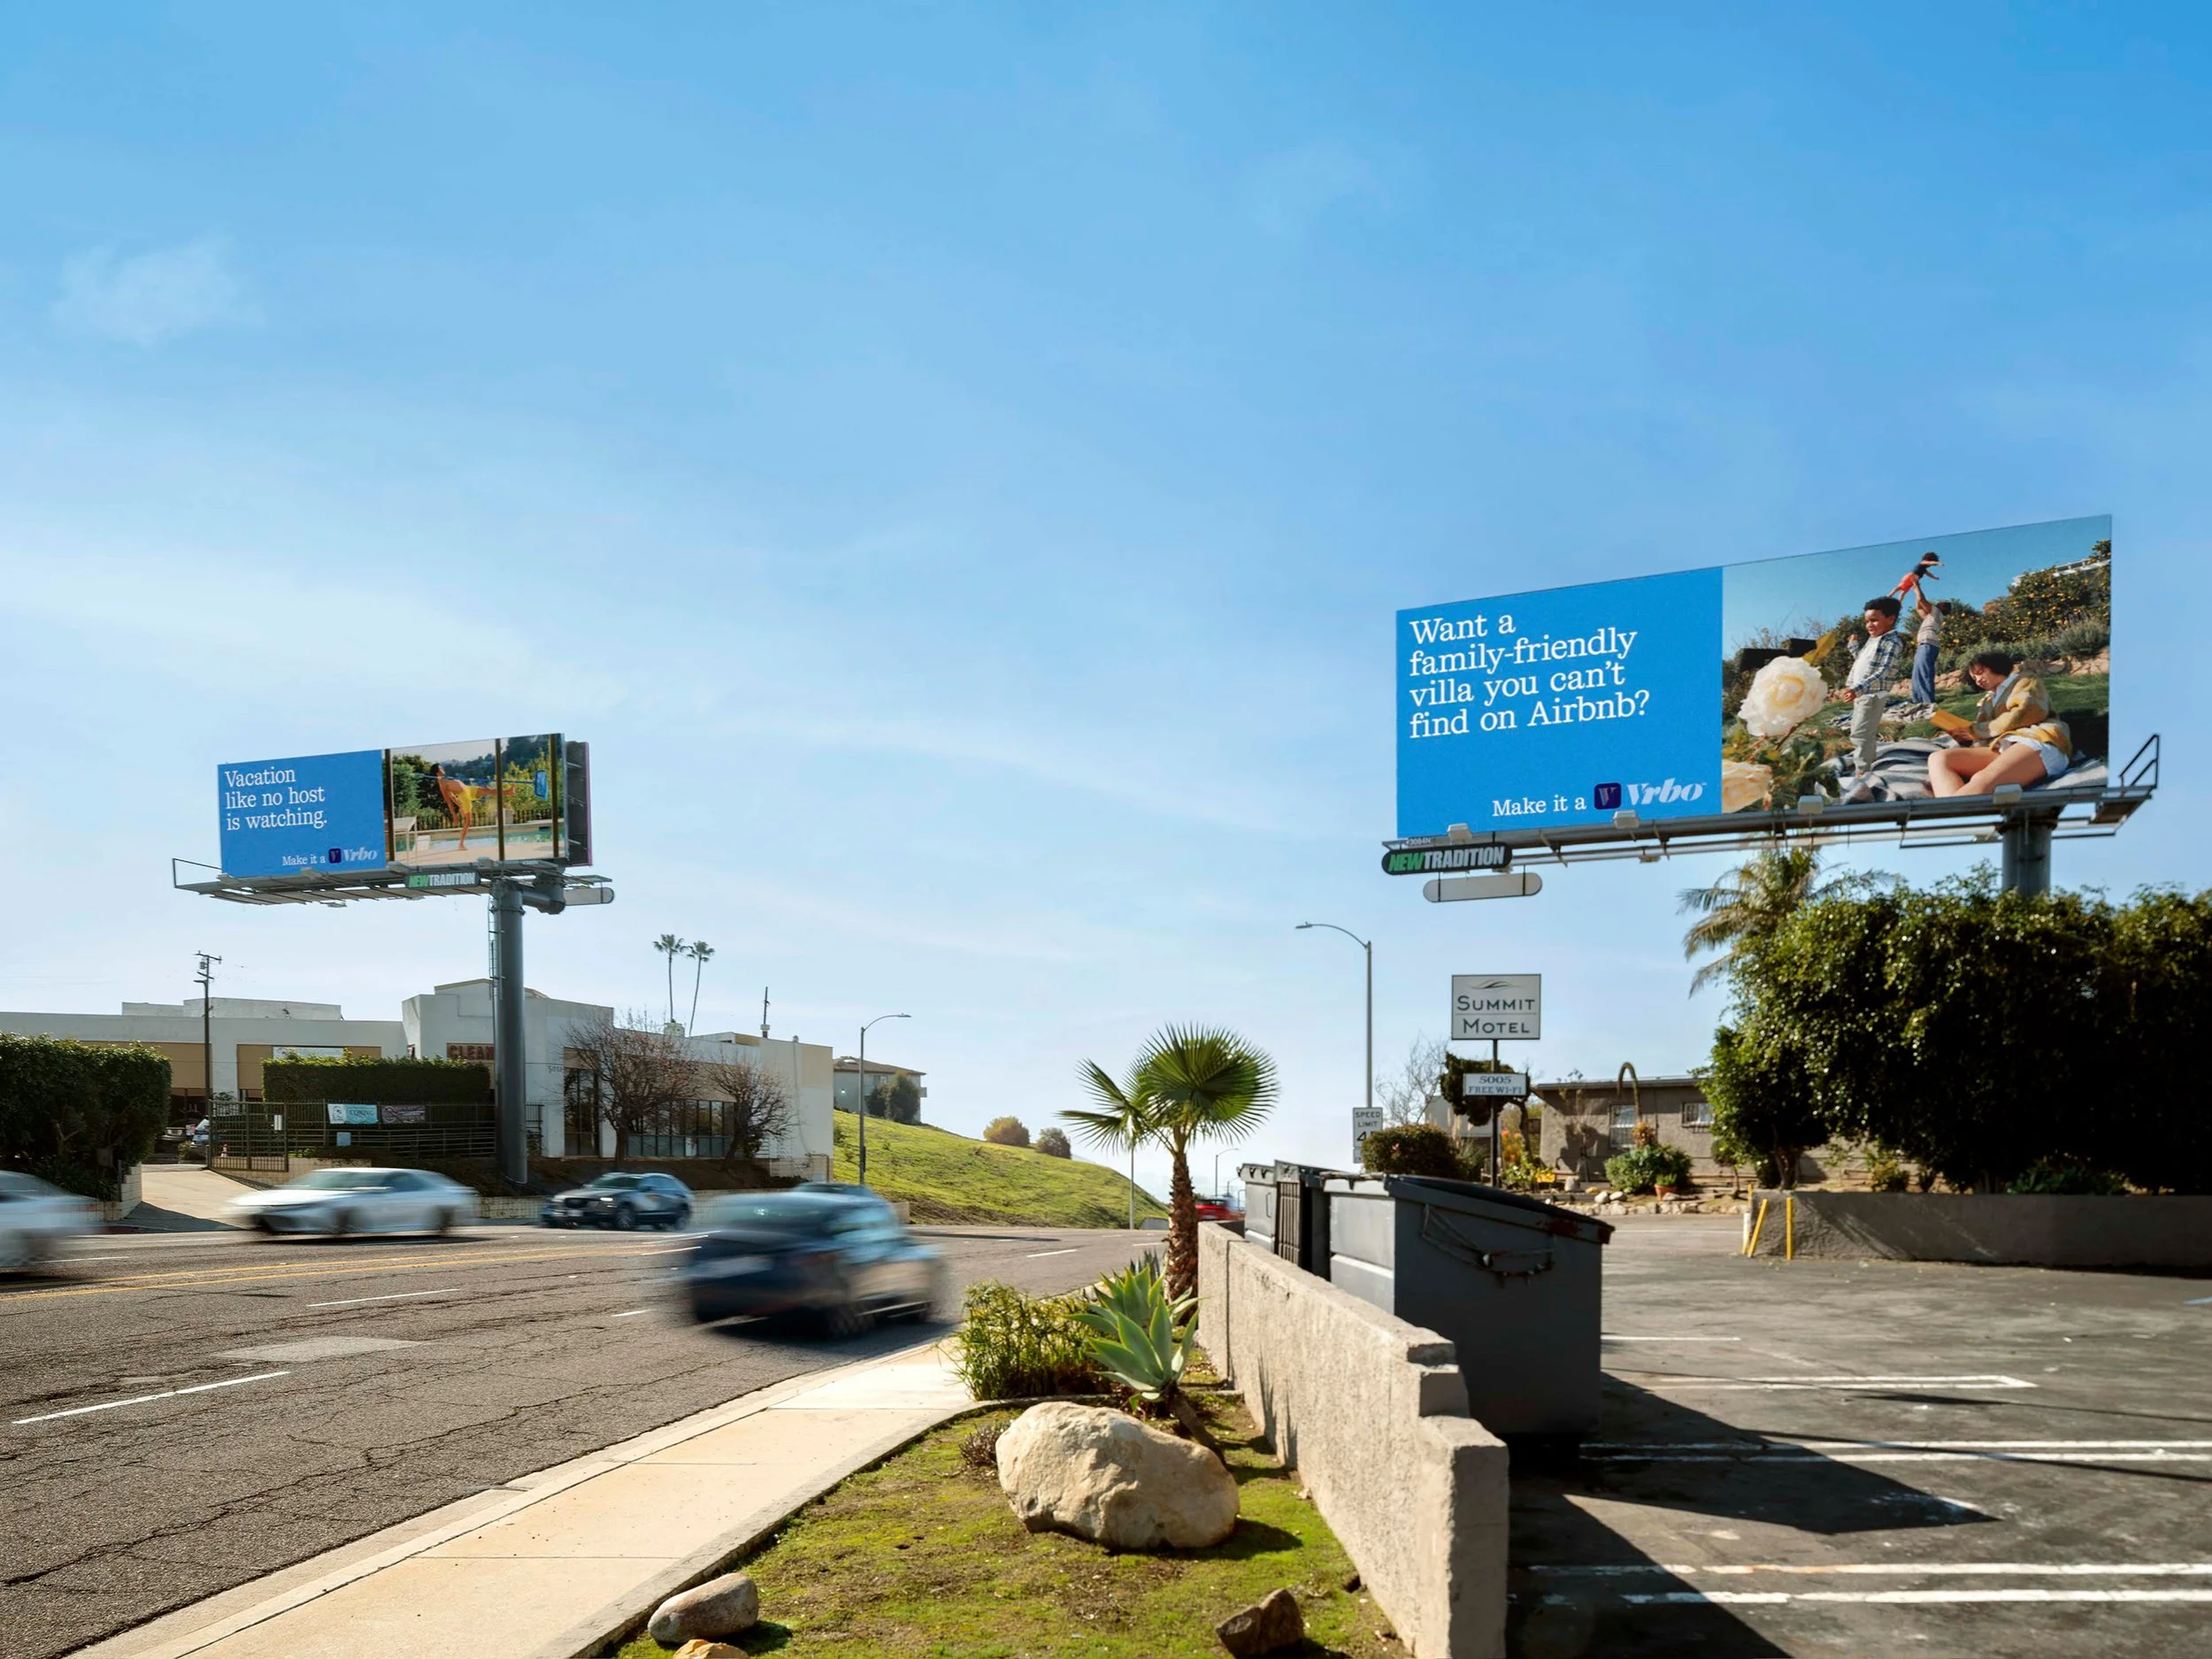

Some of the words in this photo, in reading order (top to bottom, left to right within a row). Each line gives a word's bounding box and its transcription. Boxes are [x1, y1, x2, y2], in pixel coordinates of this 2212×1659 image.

[1409, 614, 1488, 645] Want
[1498, 614, 1517, 634] a
[1409, 626, 1638, 677] family-friendly
[1409, 678, 1475, 707] villa
[1483, 675, 1539, 707] you
[1549, 660, 1625, 692] can't
[1409, 708, 1470, 739] find
[1479, 710, 1517, 732] on
[1527, 689, 1650, 726] Airbnb?
[224, 766, 296, 788] Vacation
[225, 789, 257, 810] like
[261, 792, 283, 808] no
[288, 785, 326, 804] host
[1493, 795, 1547, 817] Make
[1553, 794, 1568, 812] it
[1574, 797, 1586, 810] a
[1626, 778, 1703, 805] Vrbo
[226, 812, 241, 831] is
[244, 807, 328, 829] watching.
[282, 854, 308, 865] Make
[311, 854, 318, 864] it
[343, 847, 378, 862] Vrbo
[1456, 995, 1535, 1011] SUMMIT
[1463, 1018, 1530, 1034] MOTEL
[1479, 1075, 1512, 1084] 5005
[1356, 1131, 1374, 1141] 4
